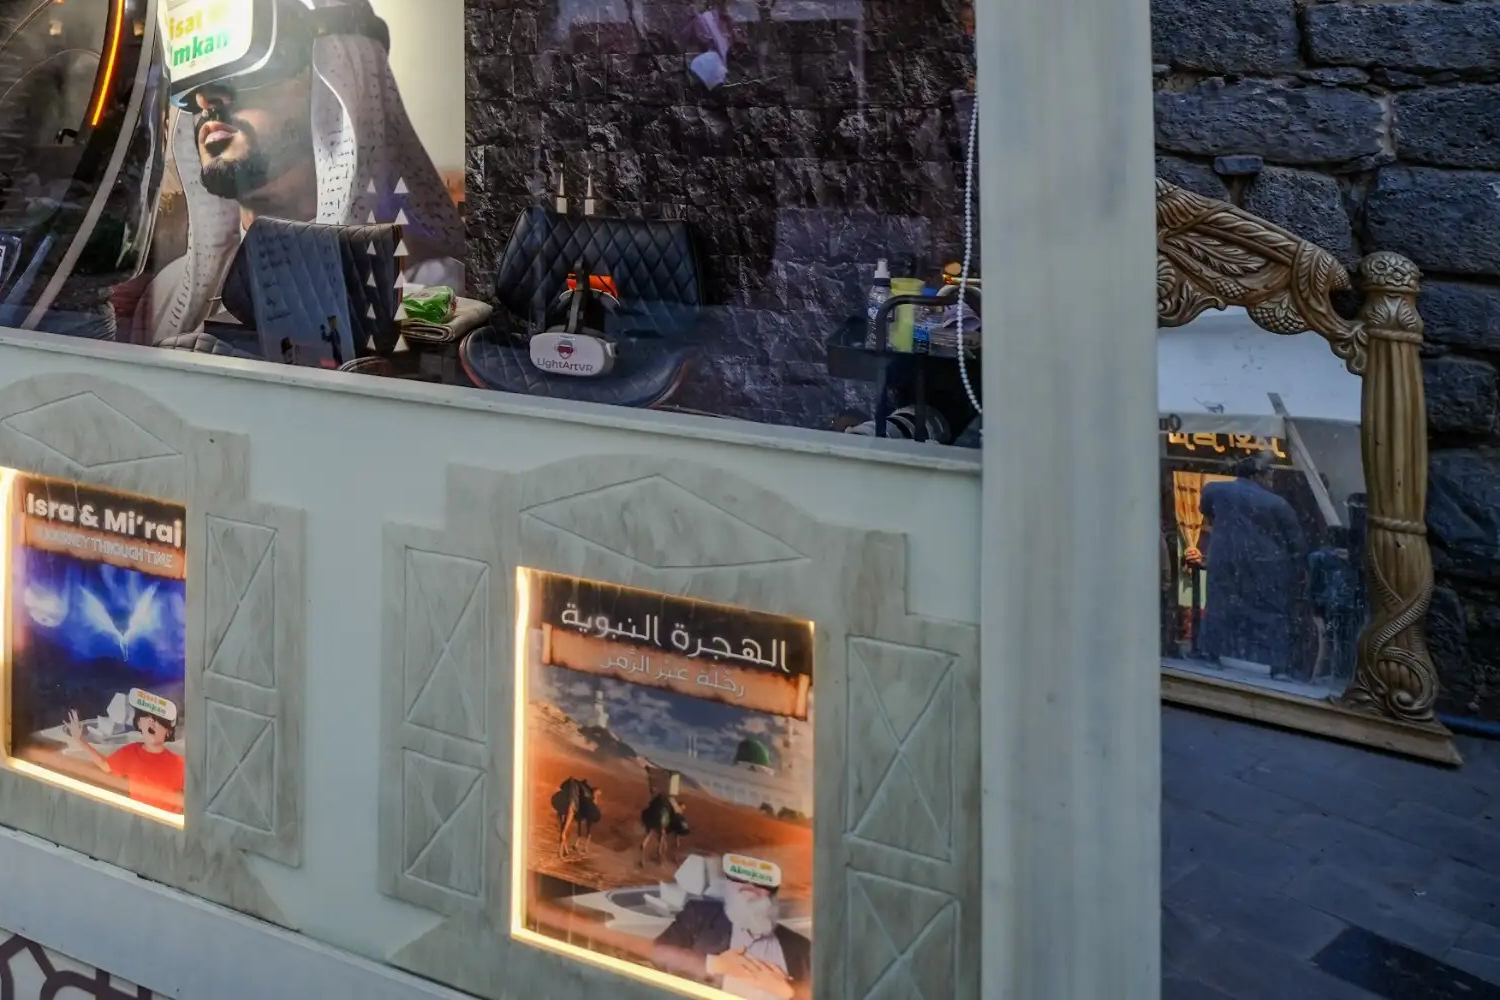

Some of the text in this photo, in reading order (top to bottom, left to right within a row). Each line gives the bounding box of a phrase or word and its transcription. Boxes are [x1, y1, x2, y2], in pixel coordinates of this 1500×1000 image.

[26, 492, 75, 522] Isra
[79, 504, 99, 528] &
[561, 602, 790, 673] الهجرة النبوية
